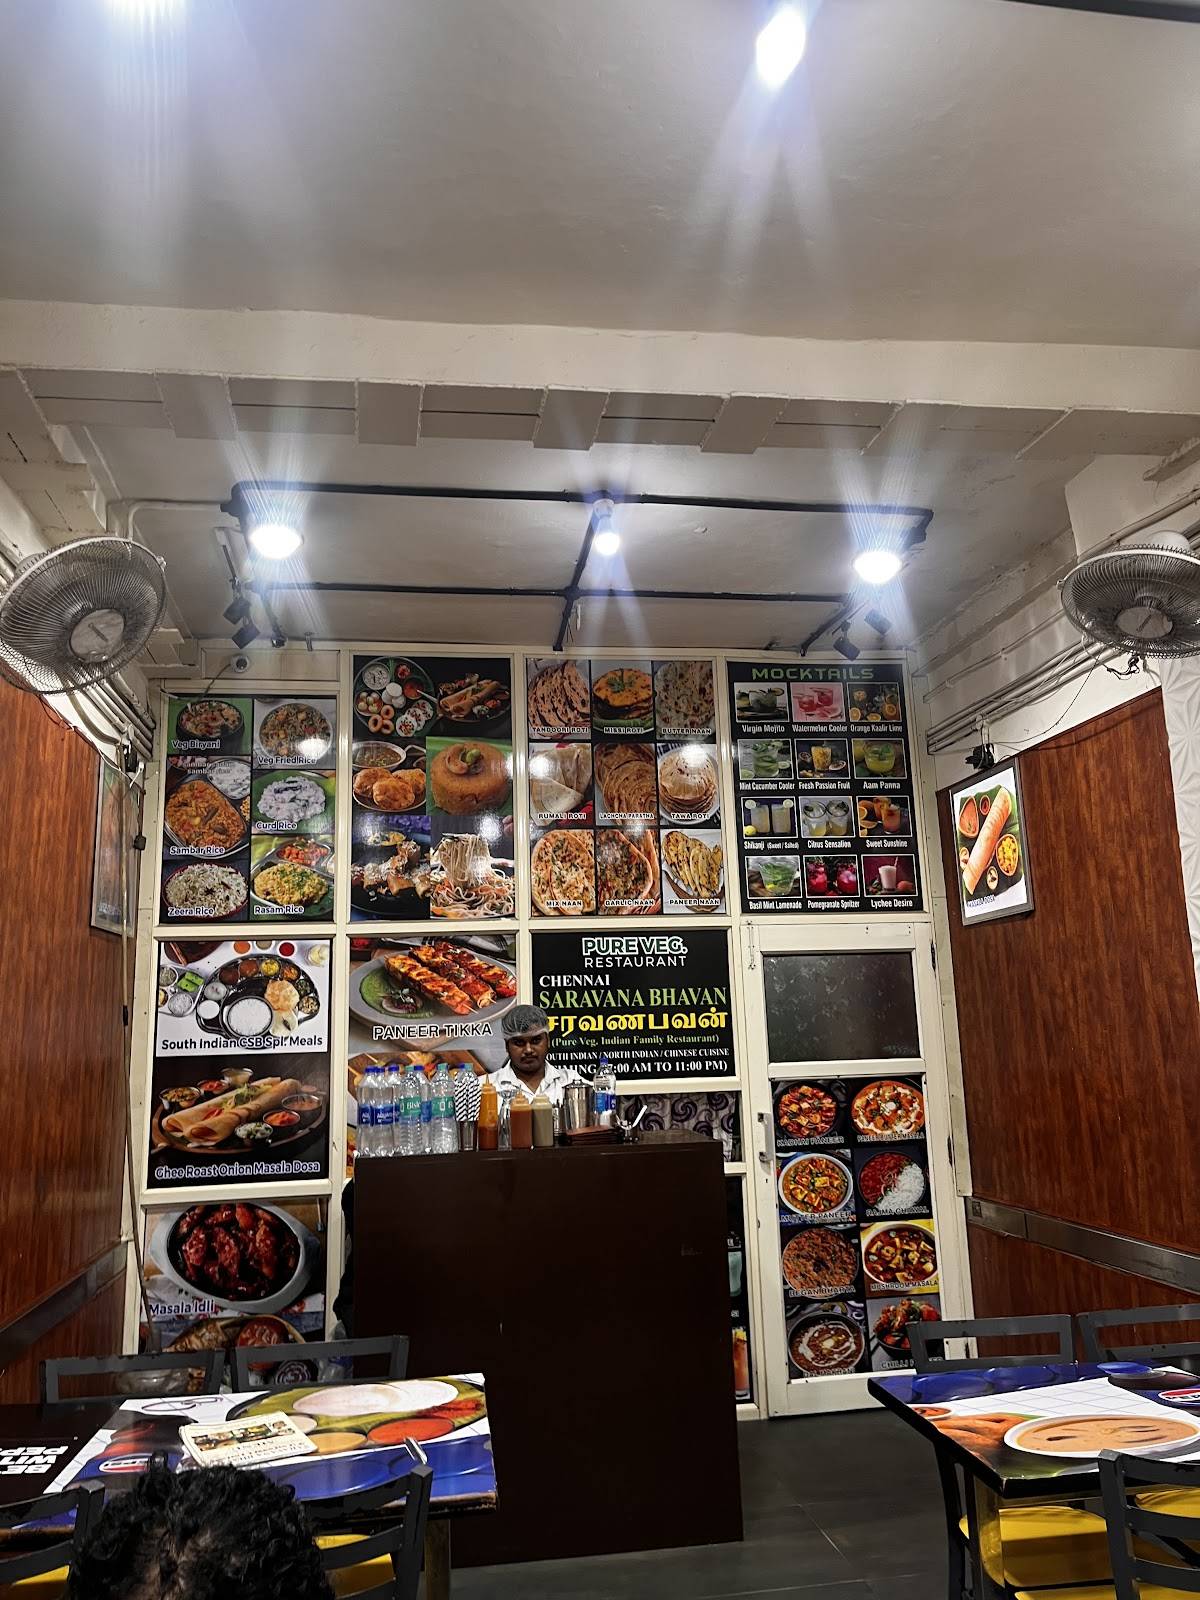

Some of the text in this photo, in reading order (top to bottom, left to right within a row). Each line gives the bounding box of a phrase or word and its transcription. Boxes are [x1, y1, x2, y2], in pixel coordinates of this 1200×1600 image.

[752, 668, 874, 680] MOCKTAILS
[742, 725, 785, 734] Virgin Mojito
[792, 725, 828, 733] Watermelon
[850, 724, 870, 732] Orange
[172, 739, 220, 750] Veg Biryani
[259, 757, 273, 766] Veg
[752, 782, 777, 790] Cucumber
[778, 782, 795, 790] Cooler
[278, 821, 297, 829] Rice
[807, 840, 851, 848] Citrus Sensation
[884, 839, 908, 847] Sunshine
[170, 846, 225, 855] Sambar Rice
[750, 901, 762, 909] Basil
[808, 901, 839, 909] Pomegranate
[871, 898, 913, 907] Lychee Desire
[168, 907, 193, 916] Zeera
[582, 936, 688, 956] PURE VEG.
[584, 955, 687, 968] RESTAURANT
[539, 974, 610, 987] CHENNAI
[539, 987, 727, 1009] SARAVANA BHAVAN
[373, 1023, 492, 1039] PANEER TIKKA
[161, 1039, 197, 1050] South
[200, 1038, 238, 1049] Indian
[239, 1037, 263, 1048] CSB
[289, 1035, 322, 1046] Meals
[552, 1034, 719, 1047] (Pure Veg. Indian Family Restaurant)
[545, 1052, 568, 1060] OUTH
[570, 1051, 597, 1060] INDIAN
[603, 1051, 630, 1059] NORTH
[632, 1049, 659, 1058] INDIAN
[664, 1049, 697, 1057] CHINESE
[699, 1048, 729, 1056] CUISINE
[632, 1062, 652, 1073] AM
[654, 1061, 672, 1072] TO
[675, 1060, 702, 1071] 11:00
[705, 1060, 728, 1071] PM)
[156, 1162, 320, 1178] Ghee Roast Onion Masala Dosa
[150, 1300, 214, 1314] Masala Idli
[0, 1446, 69, 1456] PEP
[0, 1455, 57, 1465] WIT
[0, 1464, 51, 1474] BE
